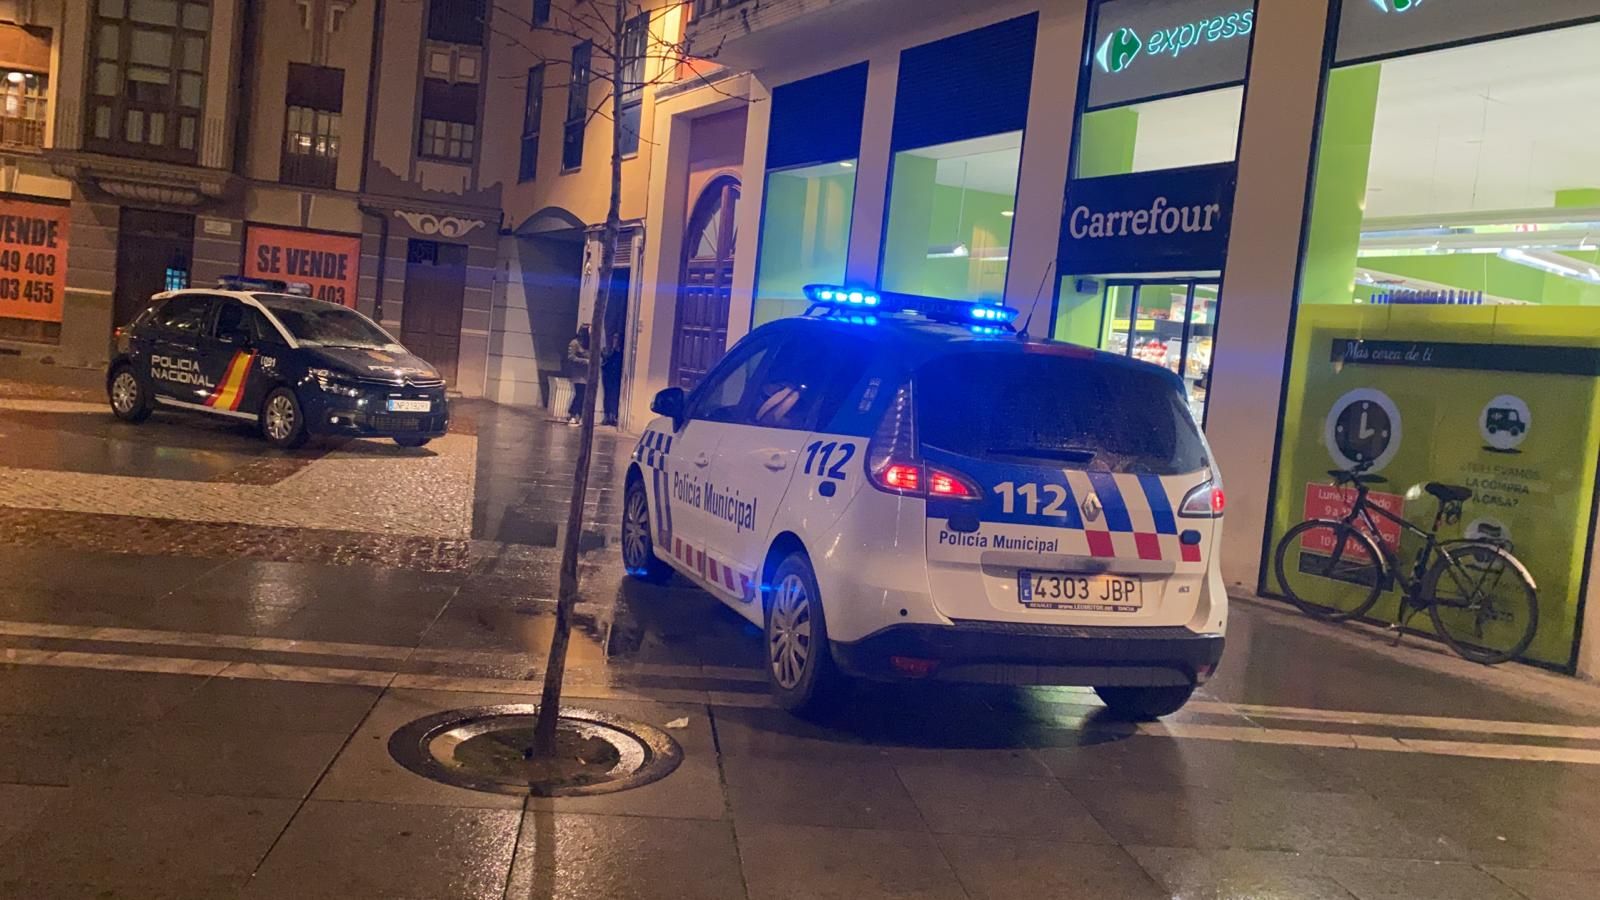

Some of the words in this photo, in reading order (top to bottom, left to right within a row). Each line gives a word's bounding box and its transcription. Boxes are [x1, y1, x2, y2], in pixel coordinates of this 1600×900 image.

[1147, 9, 1254, 57] express
[1070, 197, 1219, 239] Carrefour
[25, 252, 56, 276] 403
[257, 244, 281, 273] SE
[286, 247, 348, 280] VENDE
[23, 280, 54, 304] 455
[151, 355, 200, 373] POLICIA
[1372, 349, 1401, 361] cerca
[1404, 344, 1420, 361] de
[1422, 347, 1434, 361] ti
[151, 367, 215, 388] NACIONAL
[803, 440, 857, 481] 112
[673, 471, 701, 508] Policía
[704, 482, 757, 533] Municipal
[993, 481, 1068, 517] 112
[939, 530, 988, 548] Policía
[993, 534, 1059, 554] Municipal
[1320, 535, 1332, 547] 10
[1034, 576, 1090, 600] 4303
[1100, 579, 1136, 602] JBP
